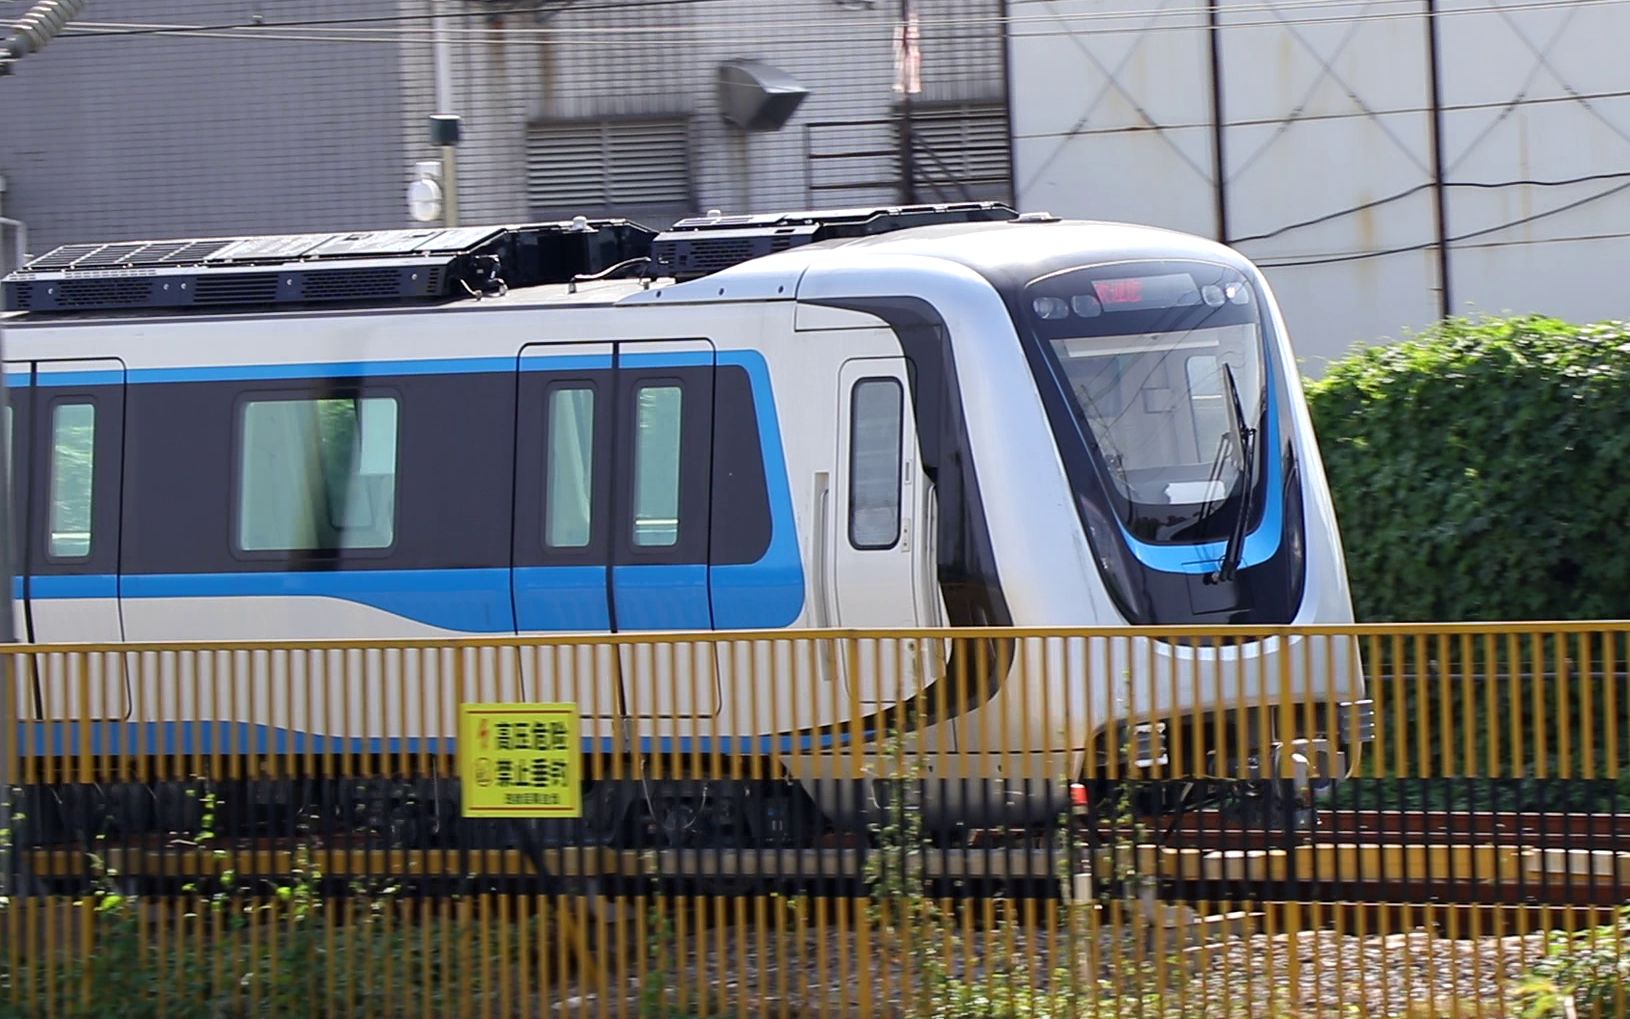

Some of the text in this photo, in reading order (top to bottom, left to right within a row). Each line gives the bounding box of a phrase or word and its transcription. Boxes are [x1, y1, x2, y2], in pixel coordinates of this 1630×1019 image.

[494, 721, 569, 751] 高压危险
[495, 758, 569, 788] 禁止垂钓
